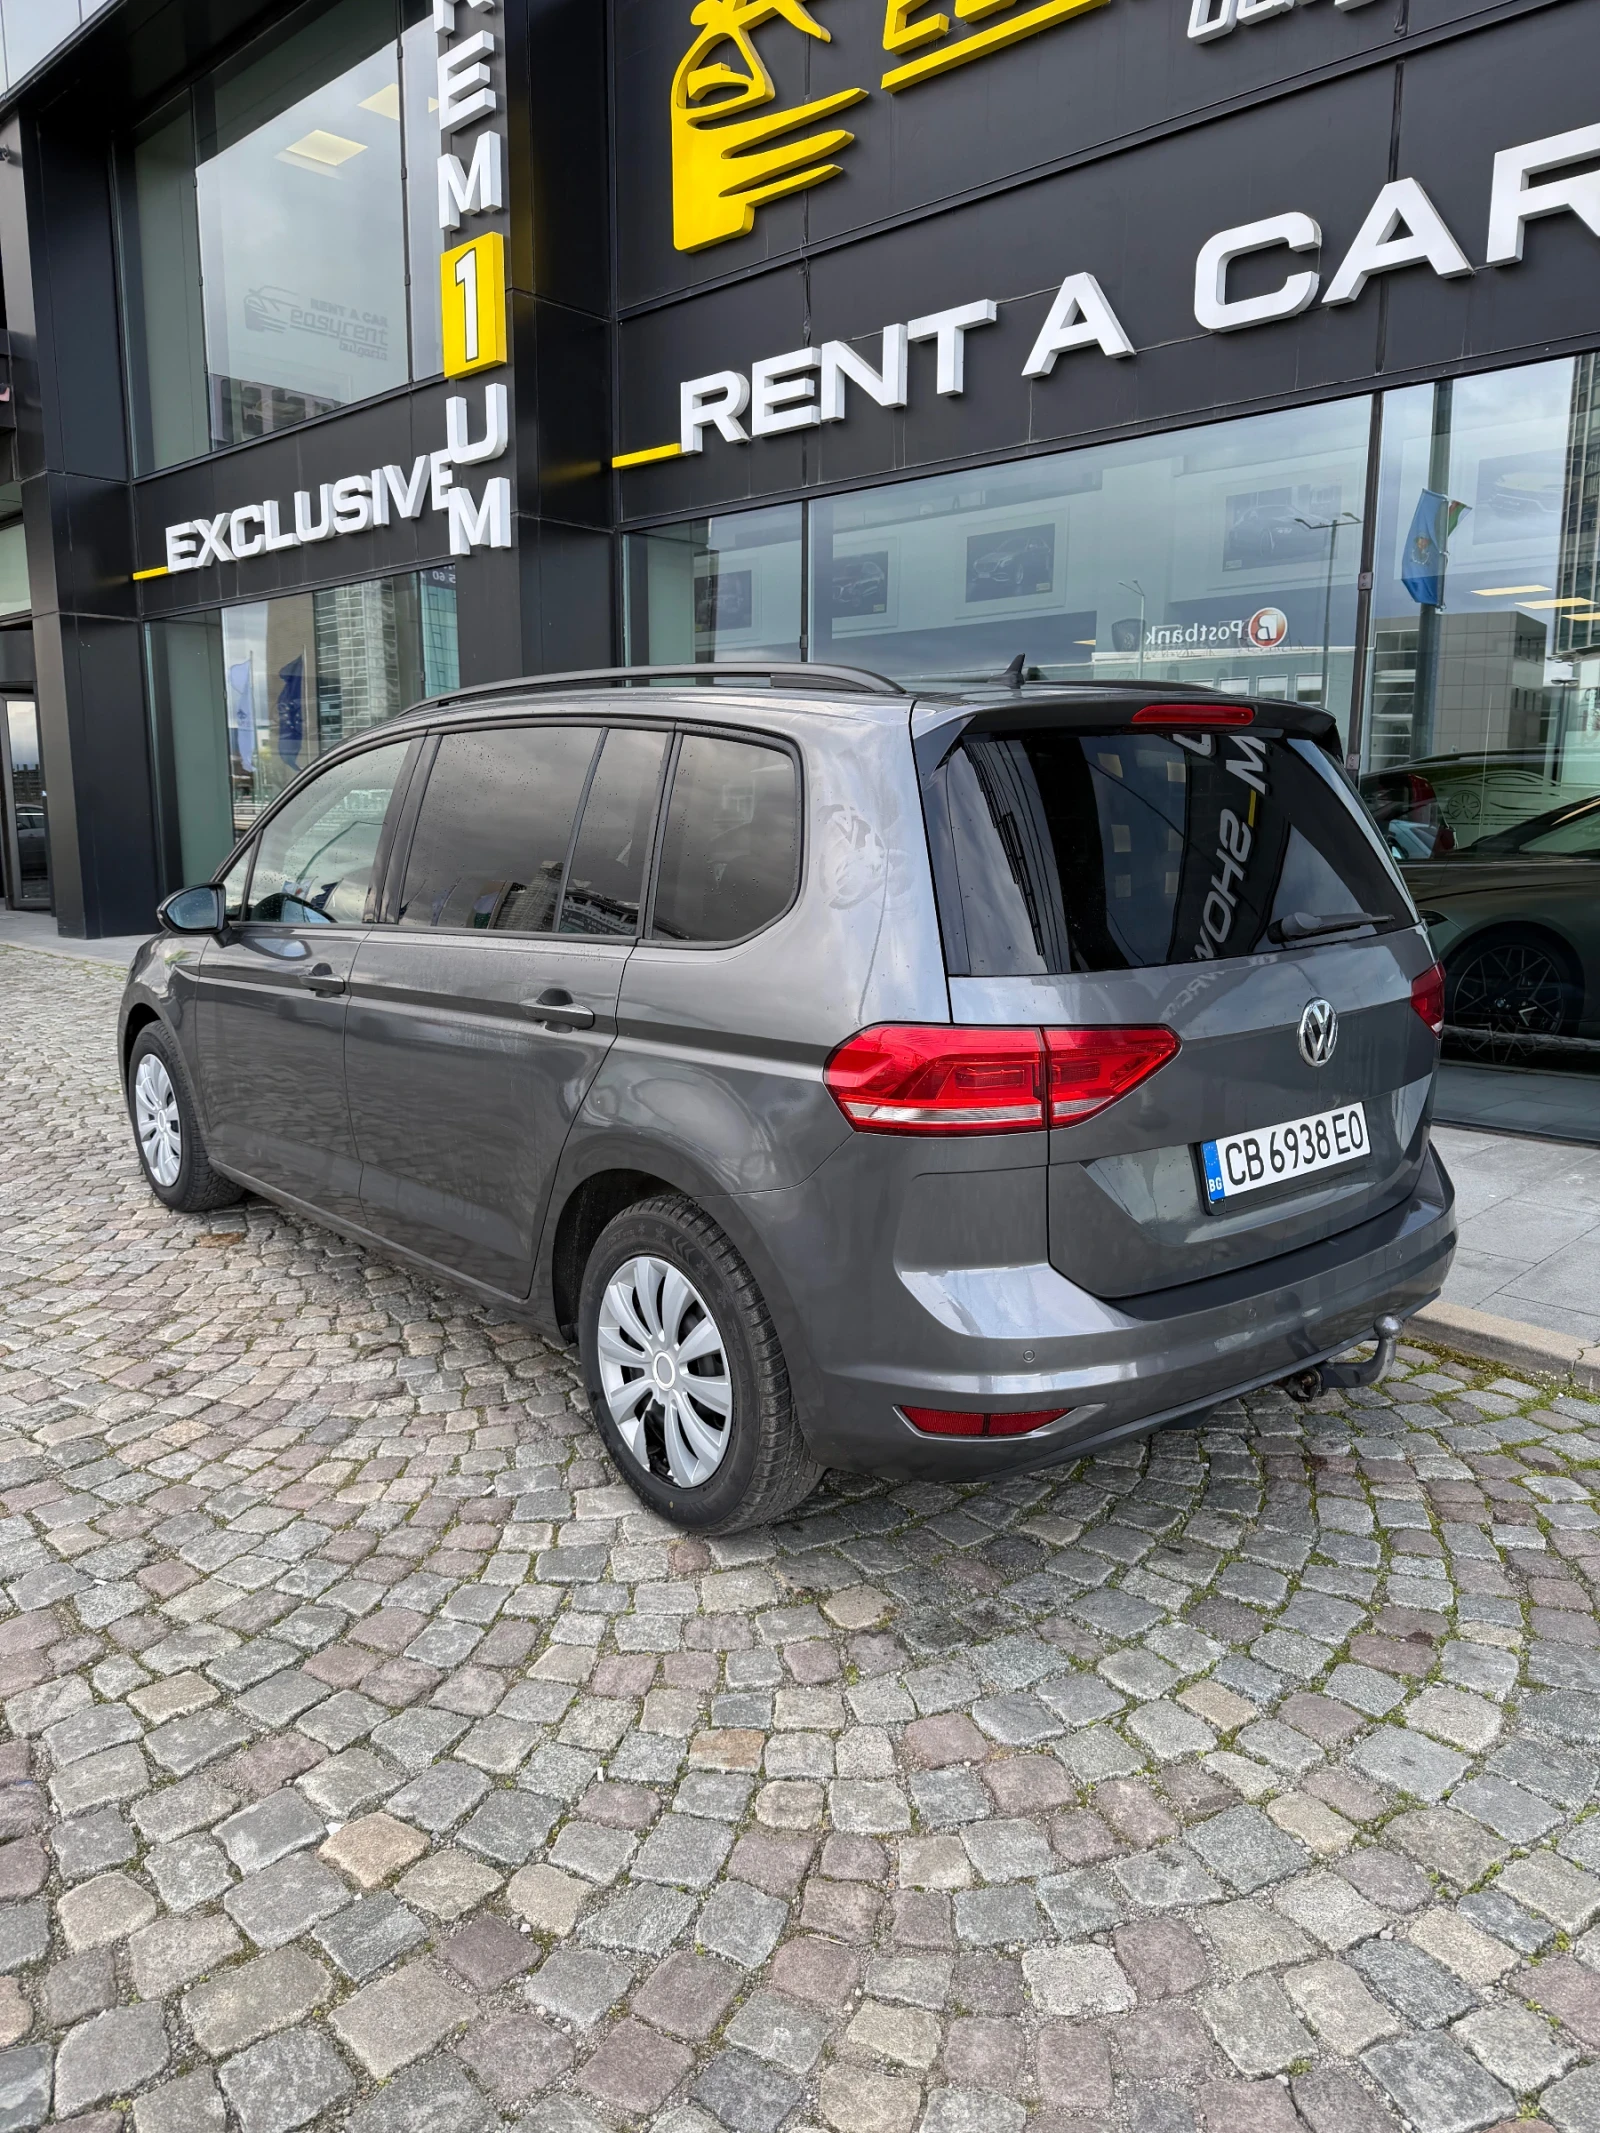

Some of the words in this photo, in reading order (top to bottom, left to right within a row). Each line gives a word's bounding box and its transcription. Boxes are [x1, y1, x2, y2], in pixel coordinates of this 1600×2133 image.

[310, 297, 348, 317] RENT
[680, 299, 997, 456] RENT
[1021, 272, 1136, 379] A
[1194, 122, 1600, 333] CAR
[290, 309, 389, 347] easyrent
[165, 448, 455, 573] EXCLUSIVE
[1225, 1137, 1265, 1186] CB
[1269, 1119, 1331, 1174] 6938
[1208, 1177, 1223, 1193] BG
